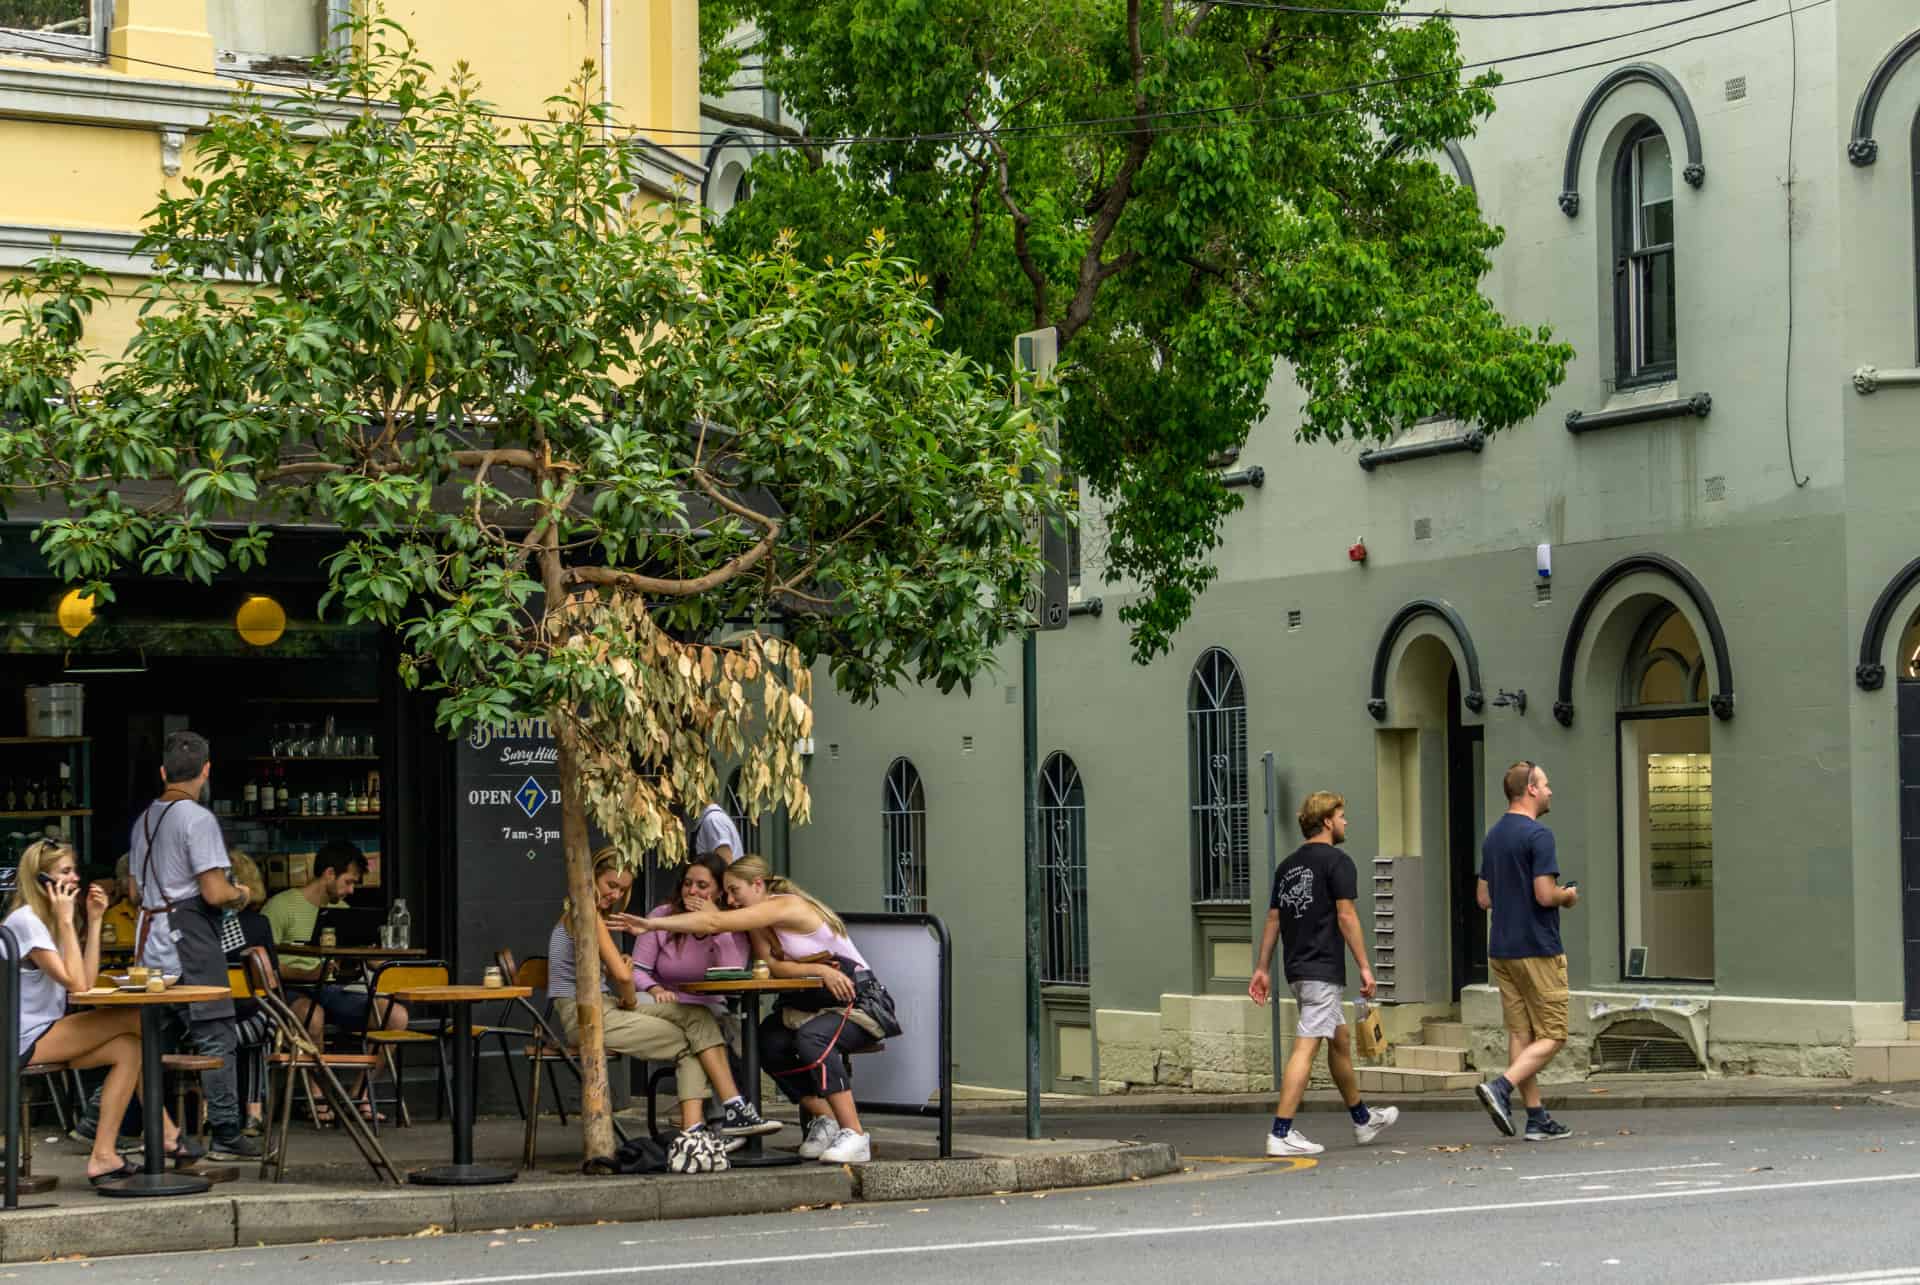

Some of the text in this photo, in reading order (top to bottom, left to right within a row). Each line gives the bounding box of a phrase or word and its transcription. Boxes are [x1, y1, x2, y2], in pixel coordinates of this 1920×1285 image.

[500, 746, 534, 766] Surry
[468, 790, 512, 805] OPEN
[524, 789, 539, 810] 7
